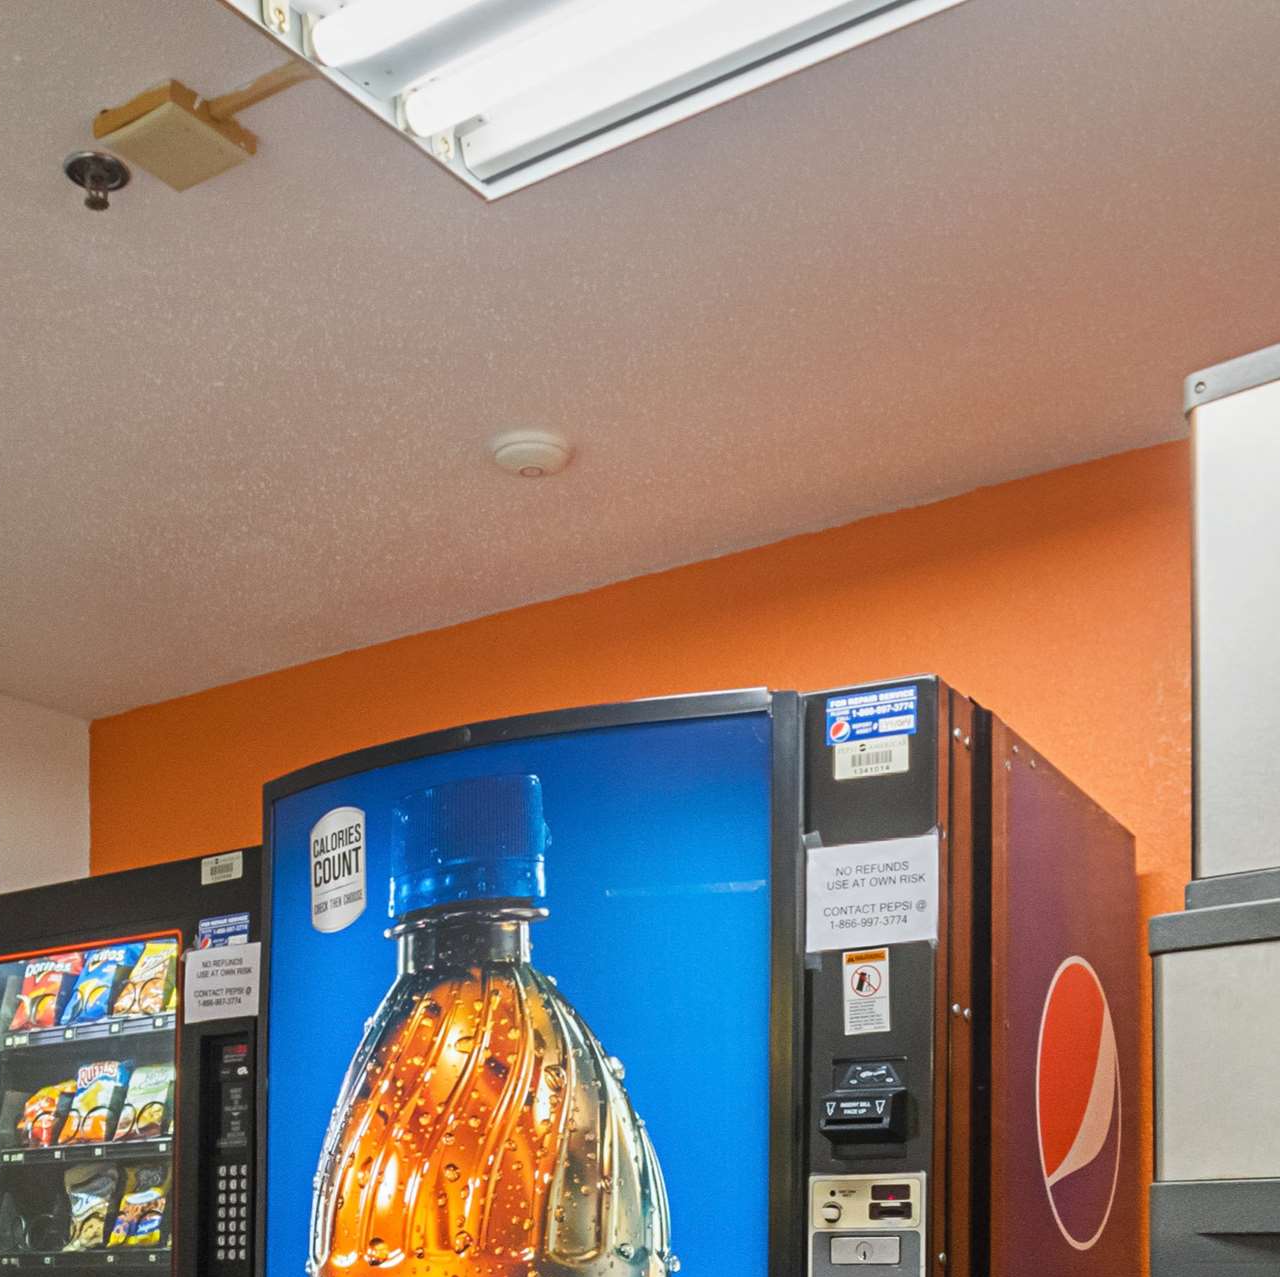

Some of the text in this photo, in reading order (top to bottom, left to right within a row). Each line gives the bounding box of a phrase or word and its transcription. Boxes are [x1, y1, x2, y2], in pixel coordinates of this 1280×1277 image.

[313, 823, 362, 858] CALORIES
[314, 846, 362, 888] COUNT
[835, 861, 910, 877] NO REFUNDS
[826, 873, 926, 891] USE AT OWN RISK
[823, 900, 927, 918] CONTACT PEPSI @
[830, 915, 908, 930] 1-866-997-3774
[213, 957, 243, 967] REFUNDS
[196, 967, 252, 979] USE AT OWN RISK
[193, 988, 224, 998] CONTACT
[225, 987, 244, 997] PEPSI
